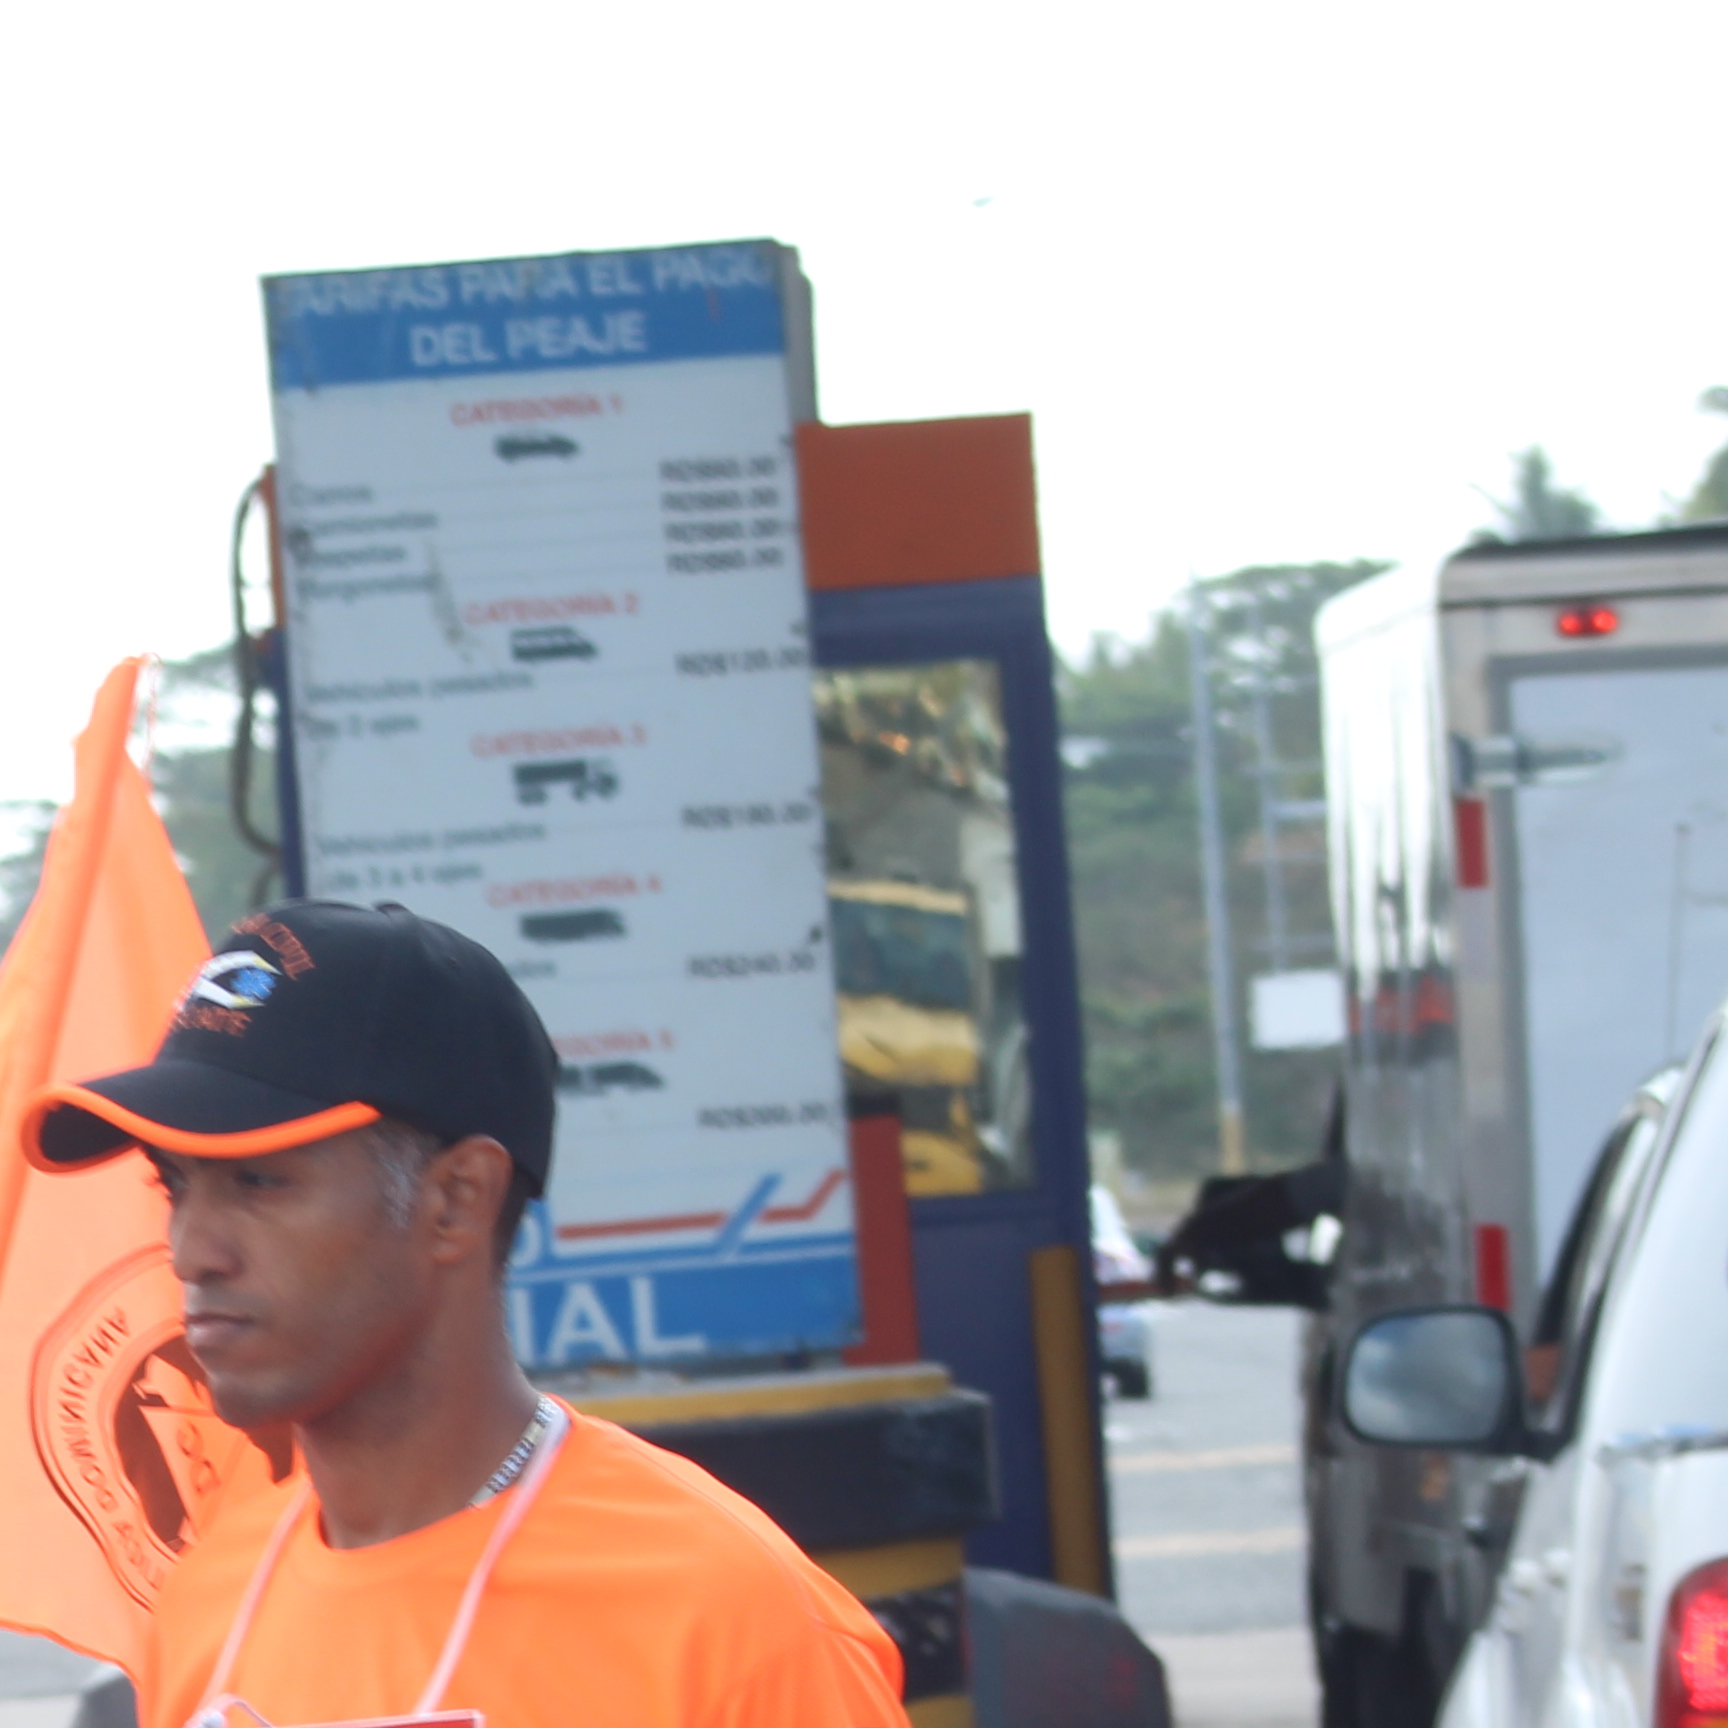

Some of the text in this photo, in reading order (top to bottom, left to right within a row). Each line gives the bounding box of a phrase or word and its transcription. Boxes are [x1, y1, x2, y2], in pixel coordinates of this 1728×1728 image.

[589, 253, 644, 296] EL
[410, 311, 648, 368] DEL PEAJE
[512, 1277, 708, 1368] IAL
